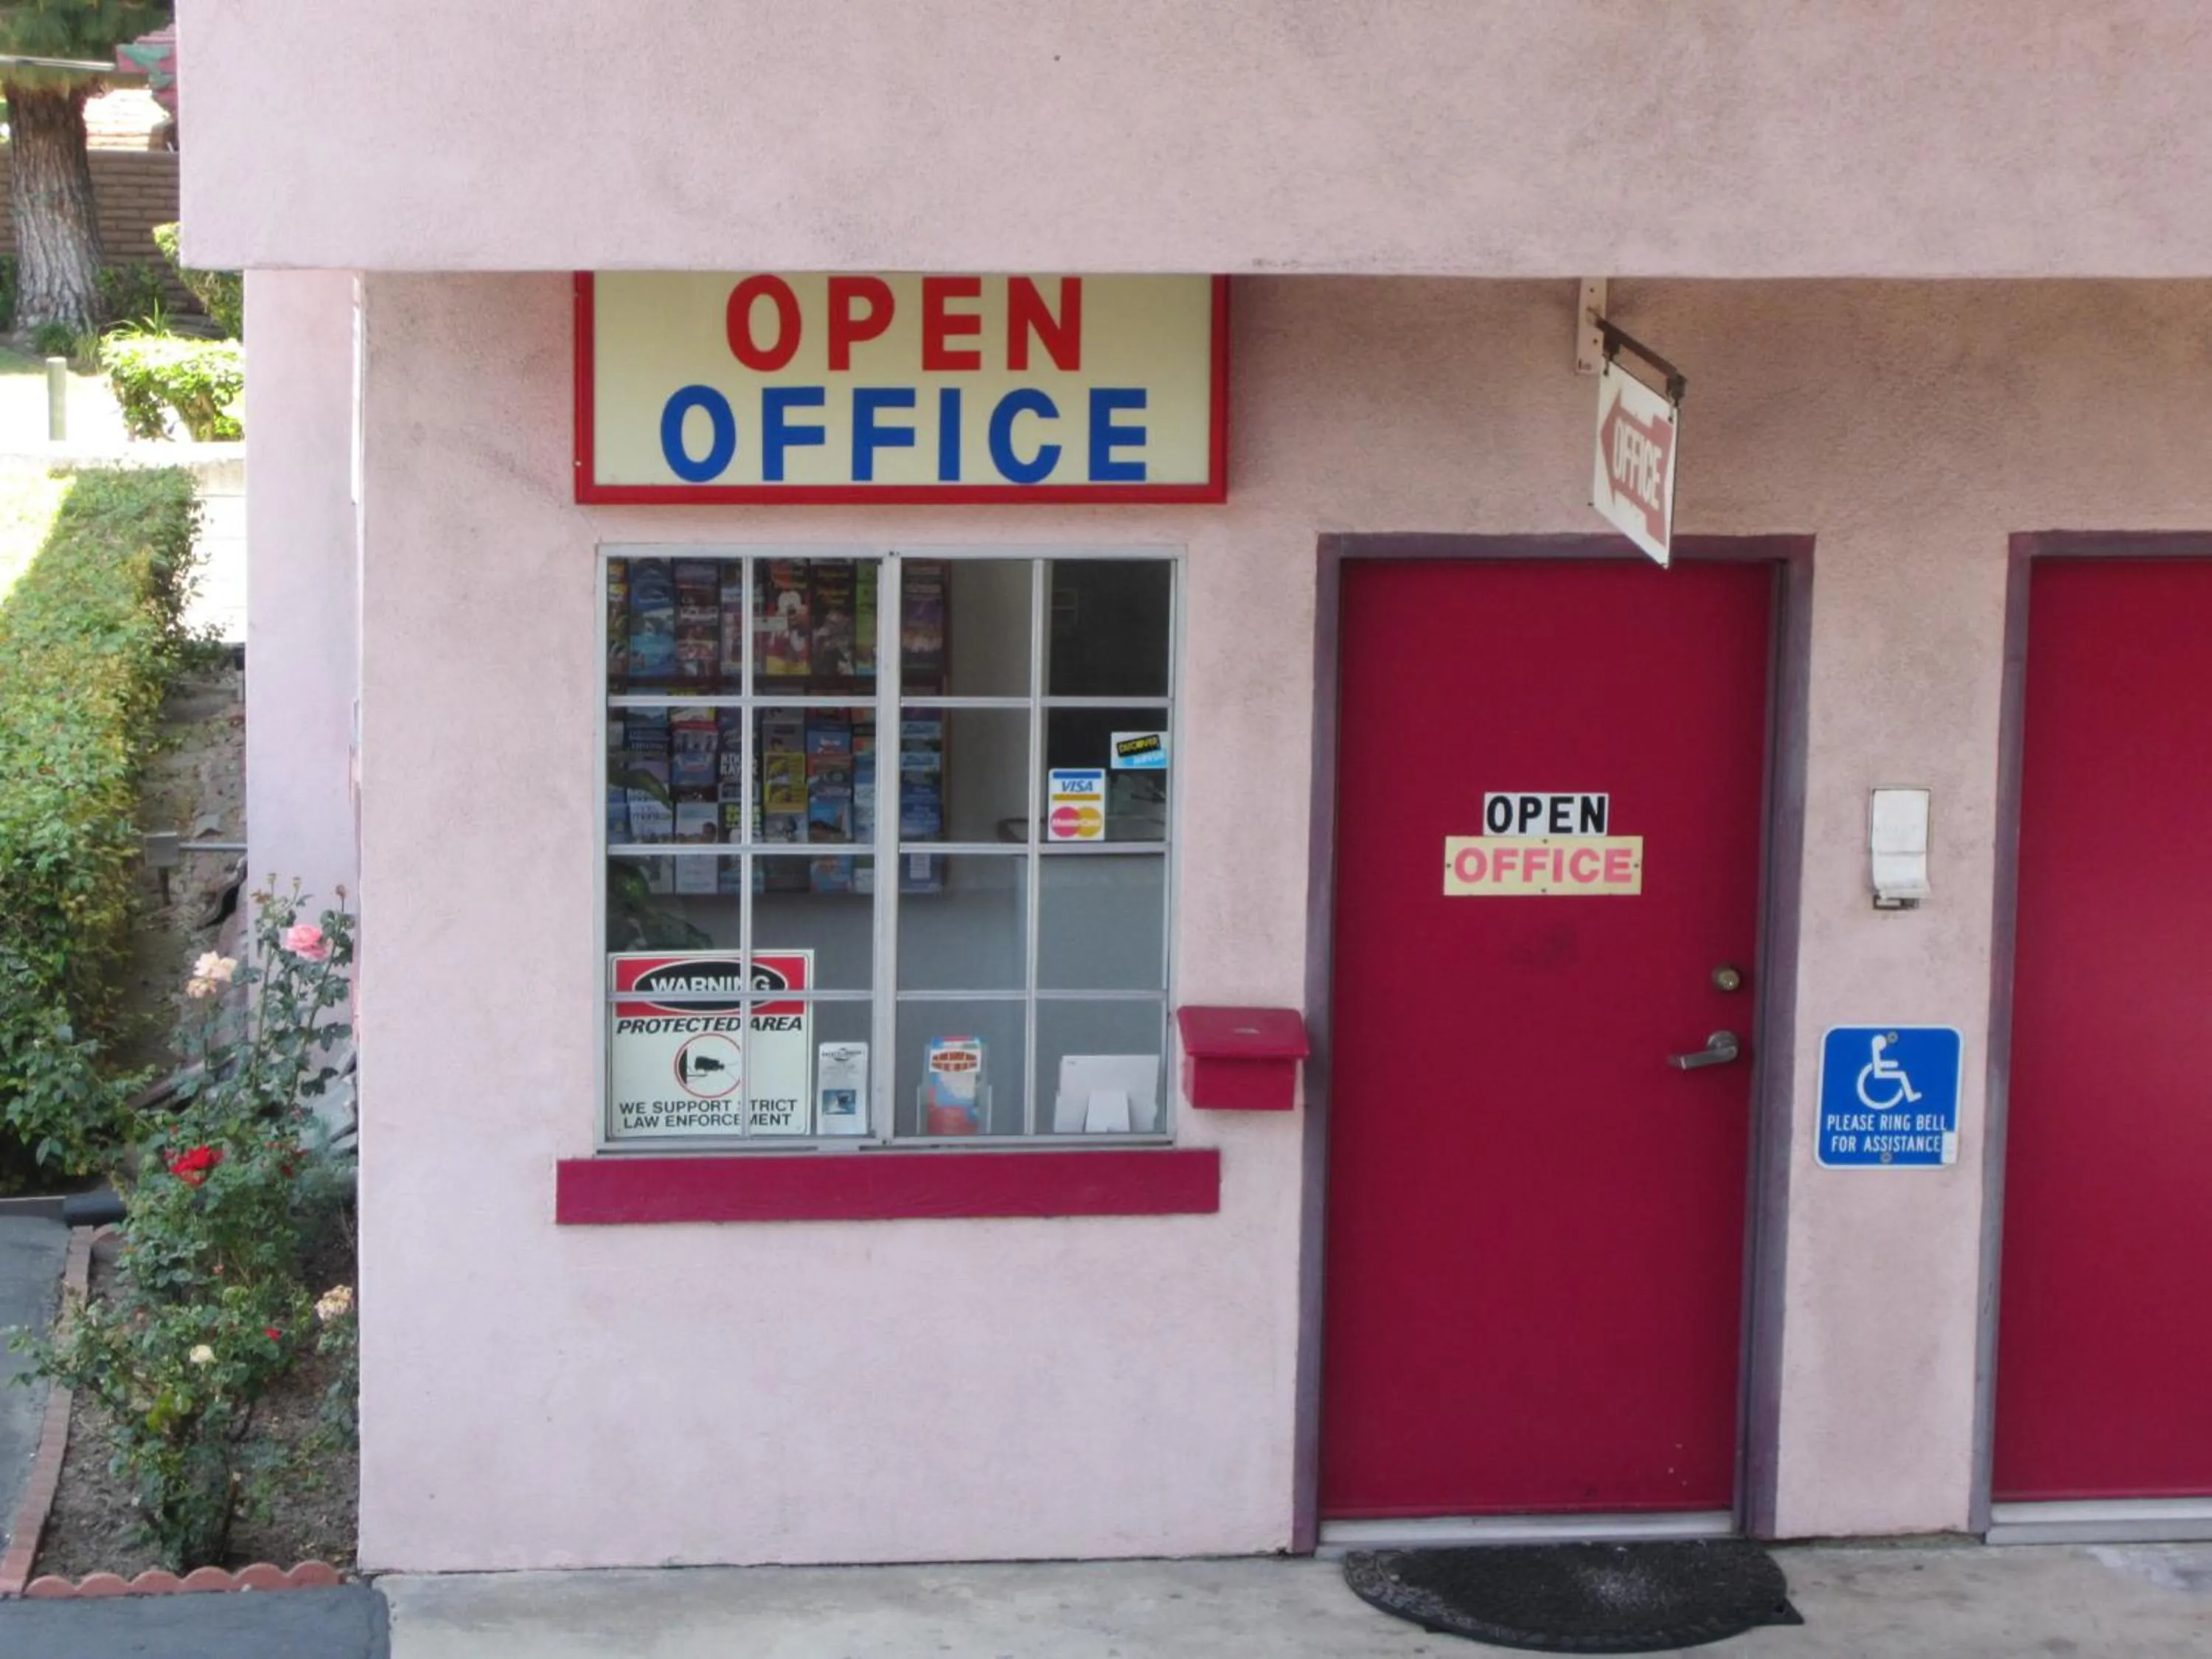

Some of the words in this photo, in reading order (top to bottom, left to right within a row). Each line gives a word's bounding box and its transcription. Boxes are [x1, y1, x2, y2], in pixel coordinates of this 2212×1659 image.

[726, 274, 1082, 372] OPEN
[660, 384, 1147, 484] OFFICE
[1613, 416, 1663, 510] OFFICE
[1062, 780, 1093, 792] VISA
[1486, 795, 1606, 834] OPEN
[1454, 847, 1632, 883] OFFICE
[616, 1017, 741, 1034] PROTECTED
[750, 1017, 802, 1032] AREA
[619, 1102, 646, 1114] WE
[653, 1099, 731, 1113] SUPPORT
[738, 1099, 798, 1112] TRICT
[624, 1116, 659, 1129] LAW
[1826, 1114, 1876, 1131] PLEASE
[1880, 1114, 1910, 1131] RING
[1916, 1114, 1947, 1131] BELL
[1831, 1135, 1857, 1152] FOR
[1863, 1135, 1941, 1152] ASSISTANCE
